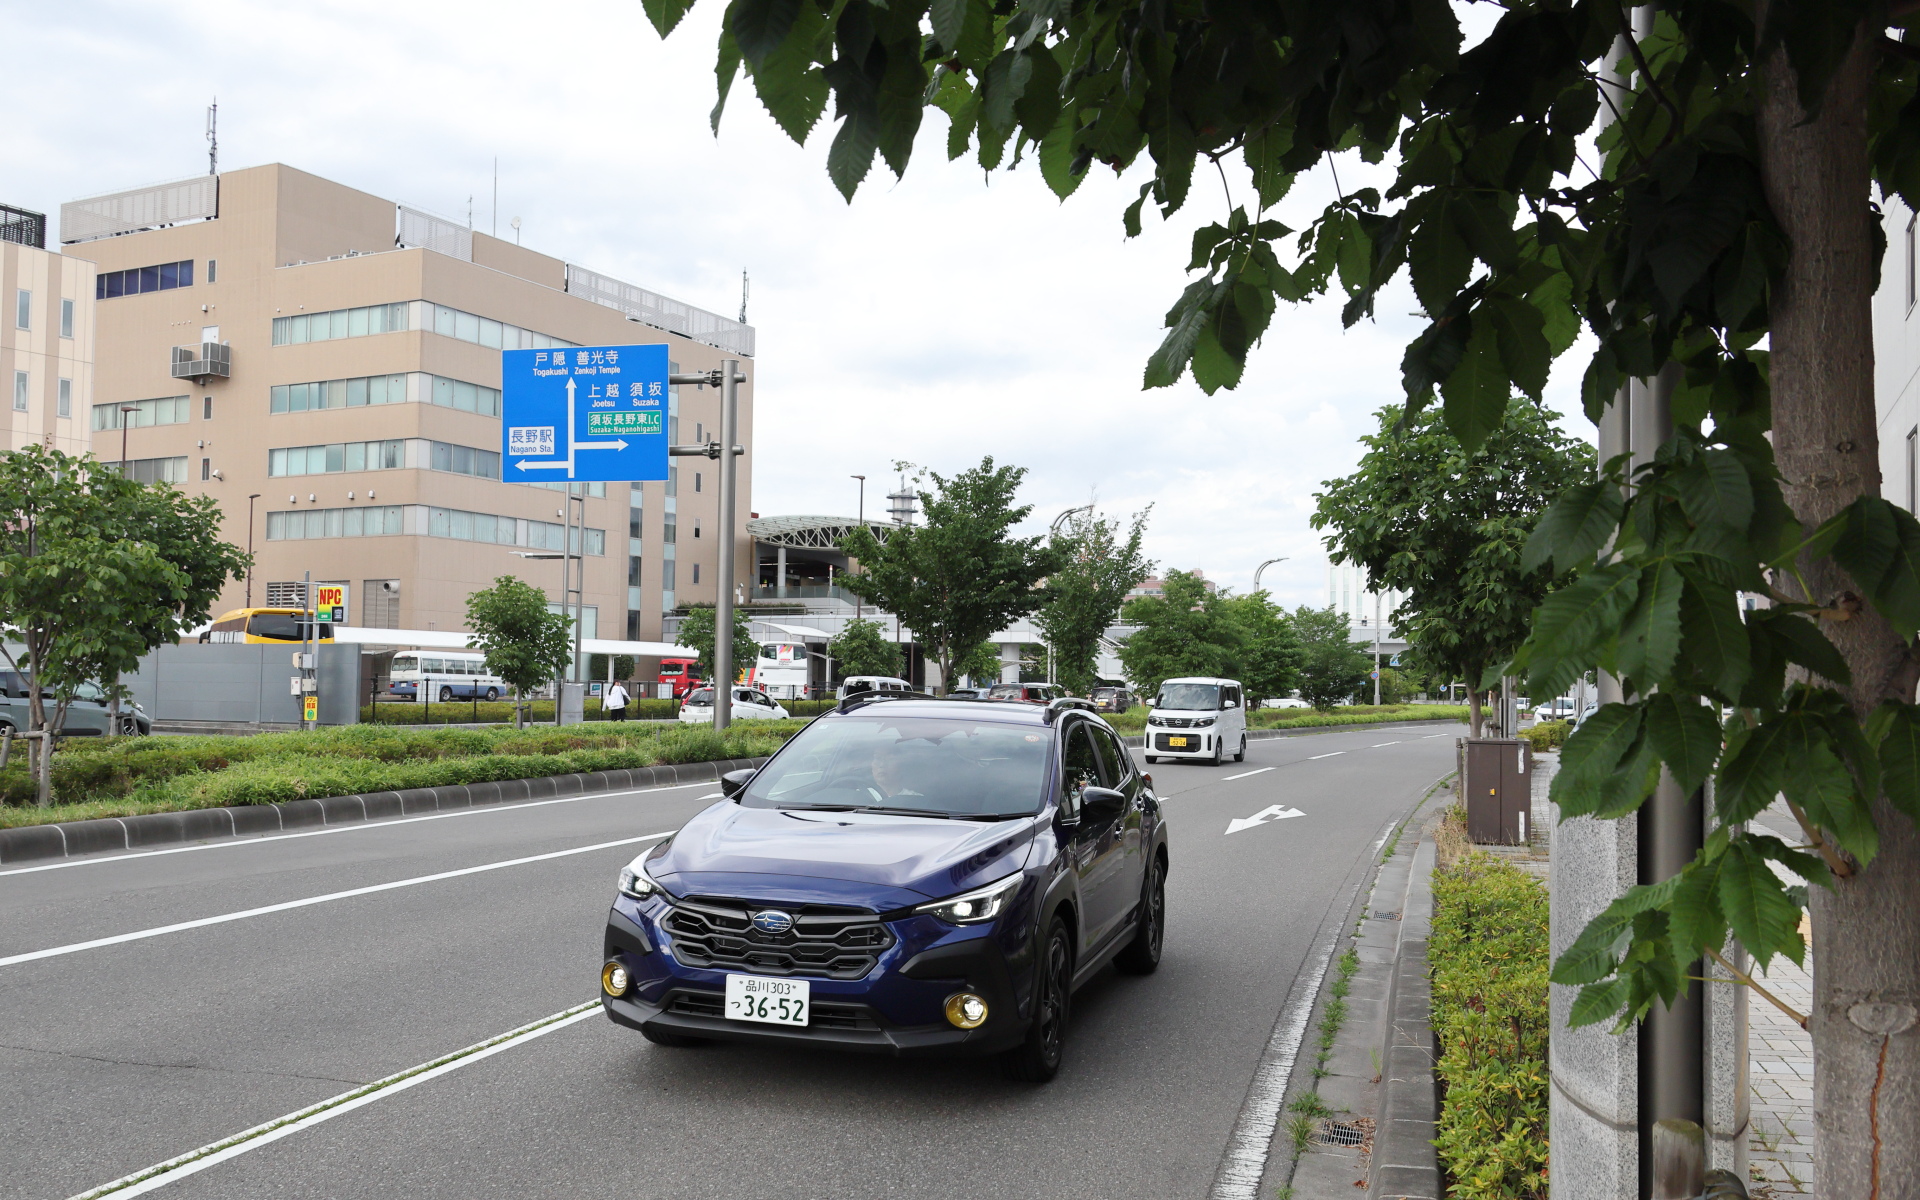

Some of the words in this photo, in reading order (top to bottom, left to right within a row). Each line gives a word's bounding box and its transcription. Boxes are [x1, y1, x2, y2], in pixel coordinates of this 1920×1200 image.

[535, 351, 566, 367] 戸隠
[576, 350, 619, 365] 善光寺
[533, 368, 568, 377] Togakushi
[574, 366, 596, 376] Zenkoji
[598, 366, 620, 375] Temple
[588, 383, 620, 398] 上越
[630, 382, 662, 397] 須坂
[592, 400, 616, 408] Joetsu
[632, 398, 660, 406] Suzaka
[511, 429, 553, 444] 長野駅
[510, 445, 537, 455] Nagano
[539, 445, 553, 453] Sta.
[320, 589, 342, 604] NPC
[744, 995, 804, 1022] 36-52
